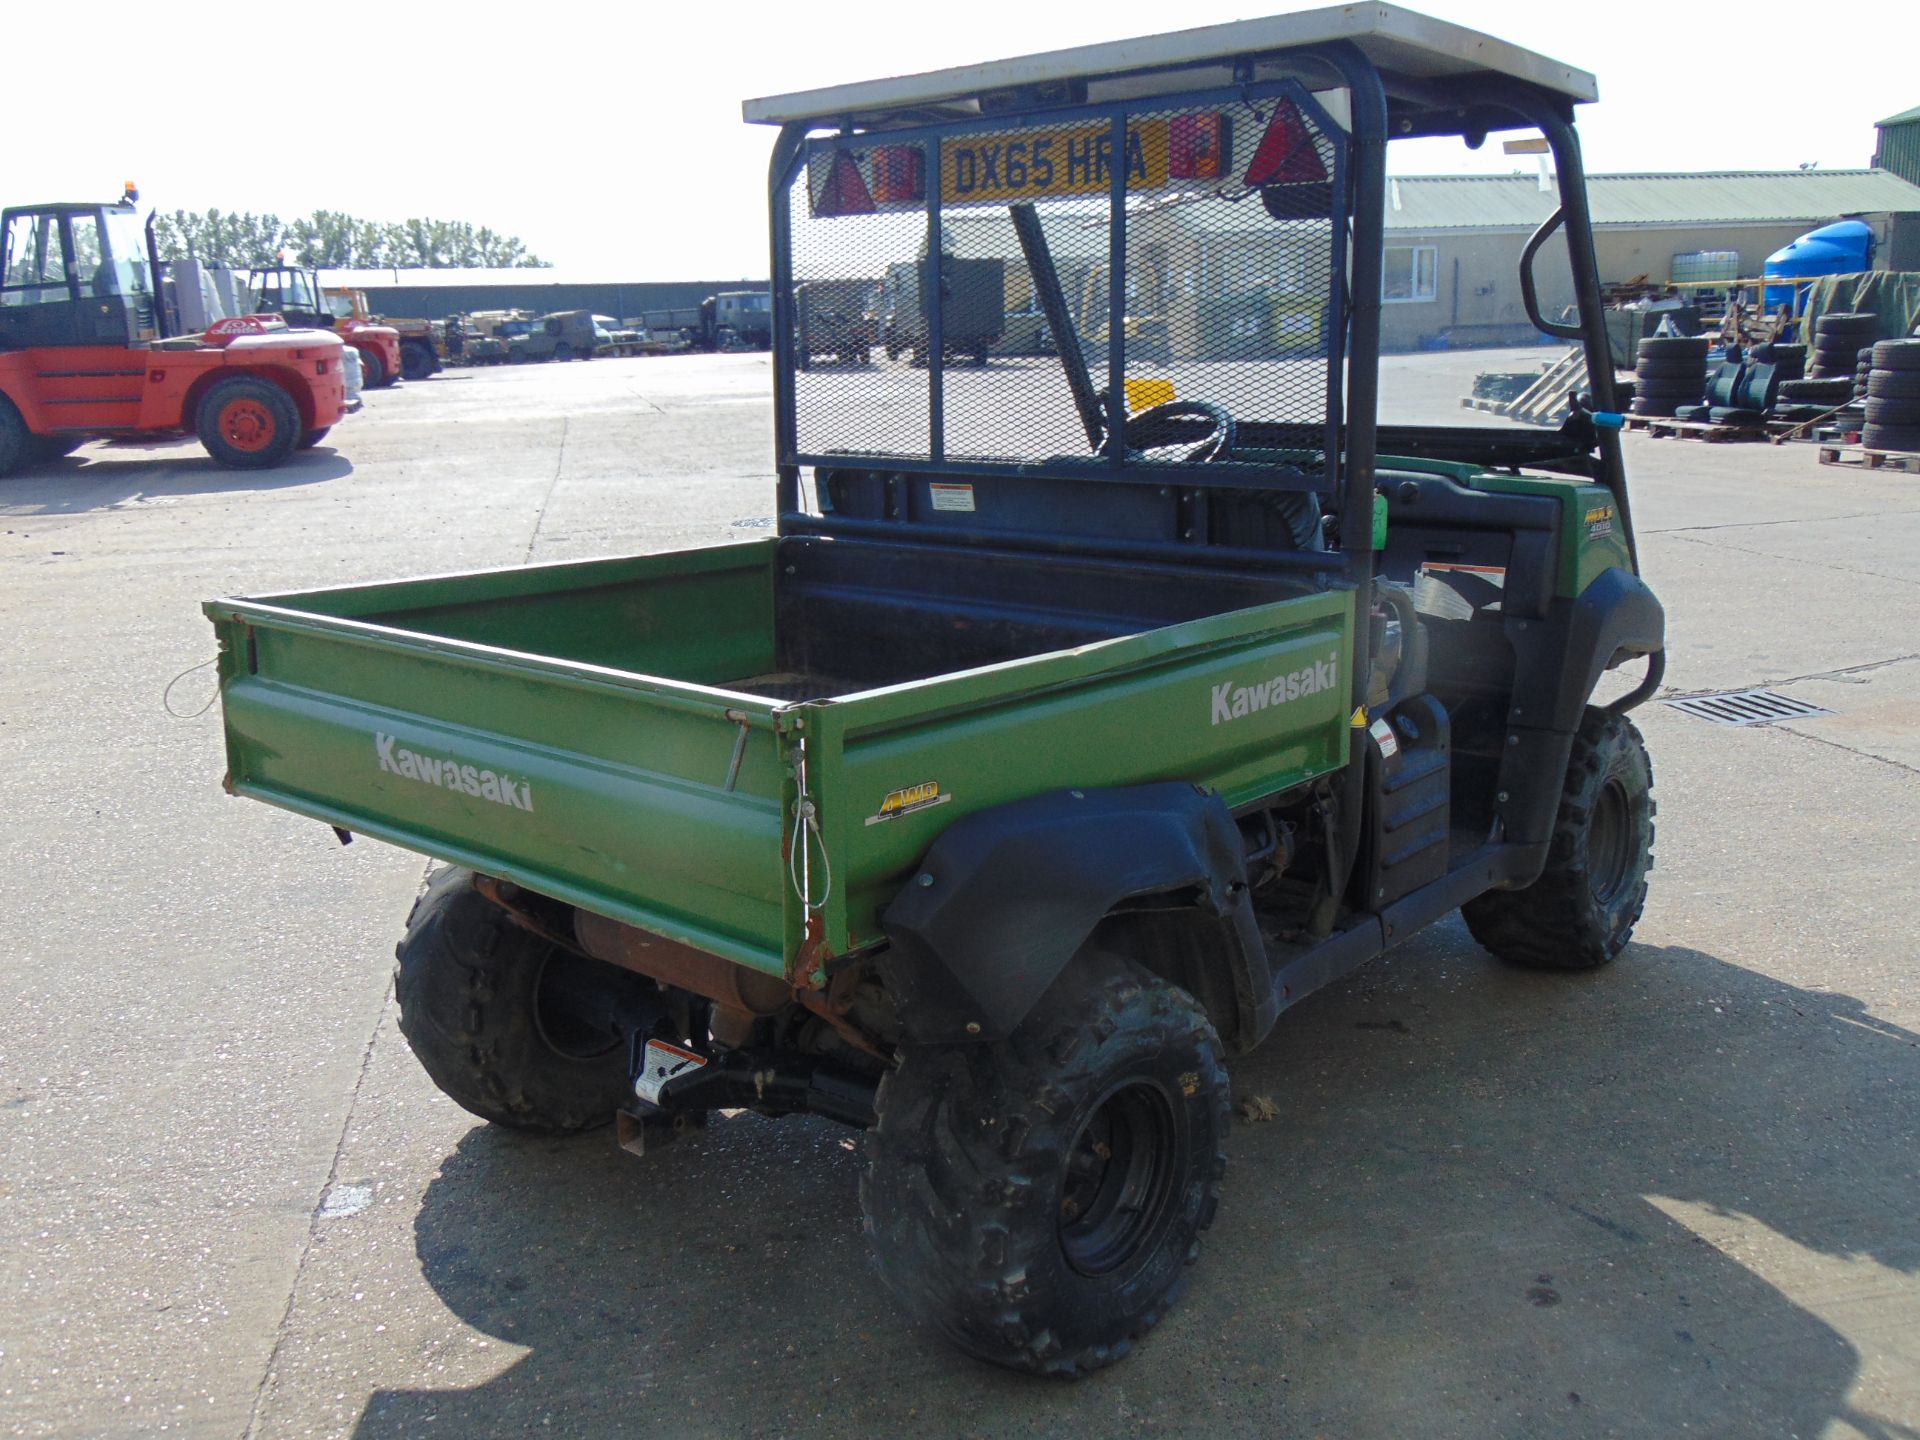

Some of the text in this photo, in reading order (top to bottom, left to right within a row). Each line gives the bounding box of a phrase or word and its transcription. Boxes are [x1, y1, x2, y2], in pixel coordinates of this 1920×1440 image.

[956, 129, 1147, 194] DX65 HRA
[1211, 651, 1338, 726] Kawasaki
[375, 731, 534, 812] Kawasaki
[879, 781, 938, 818] 4WD
